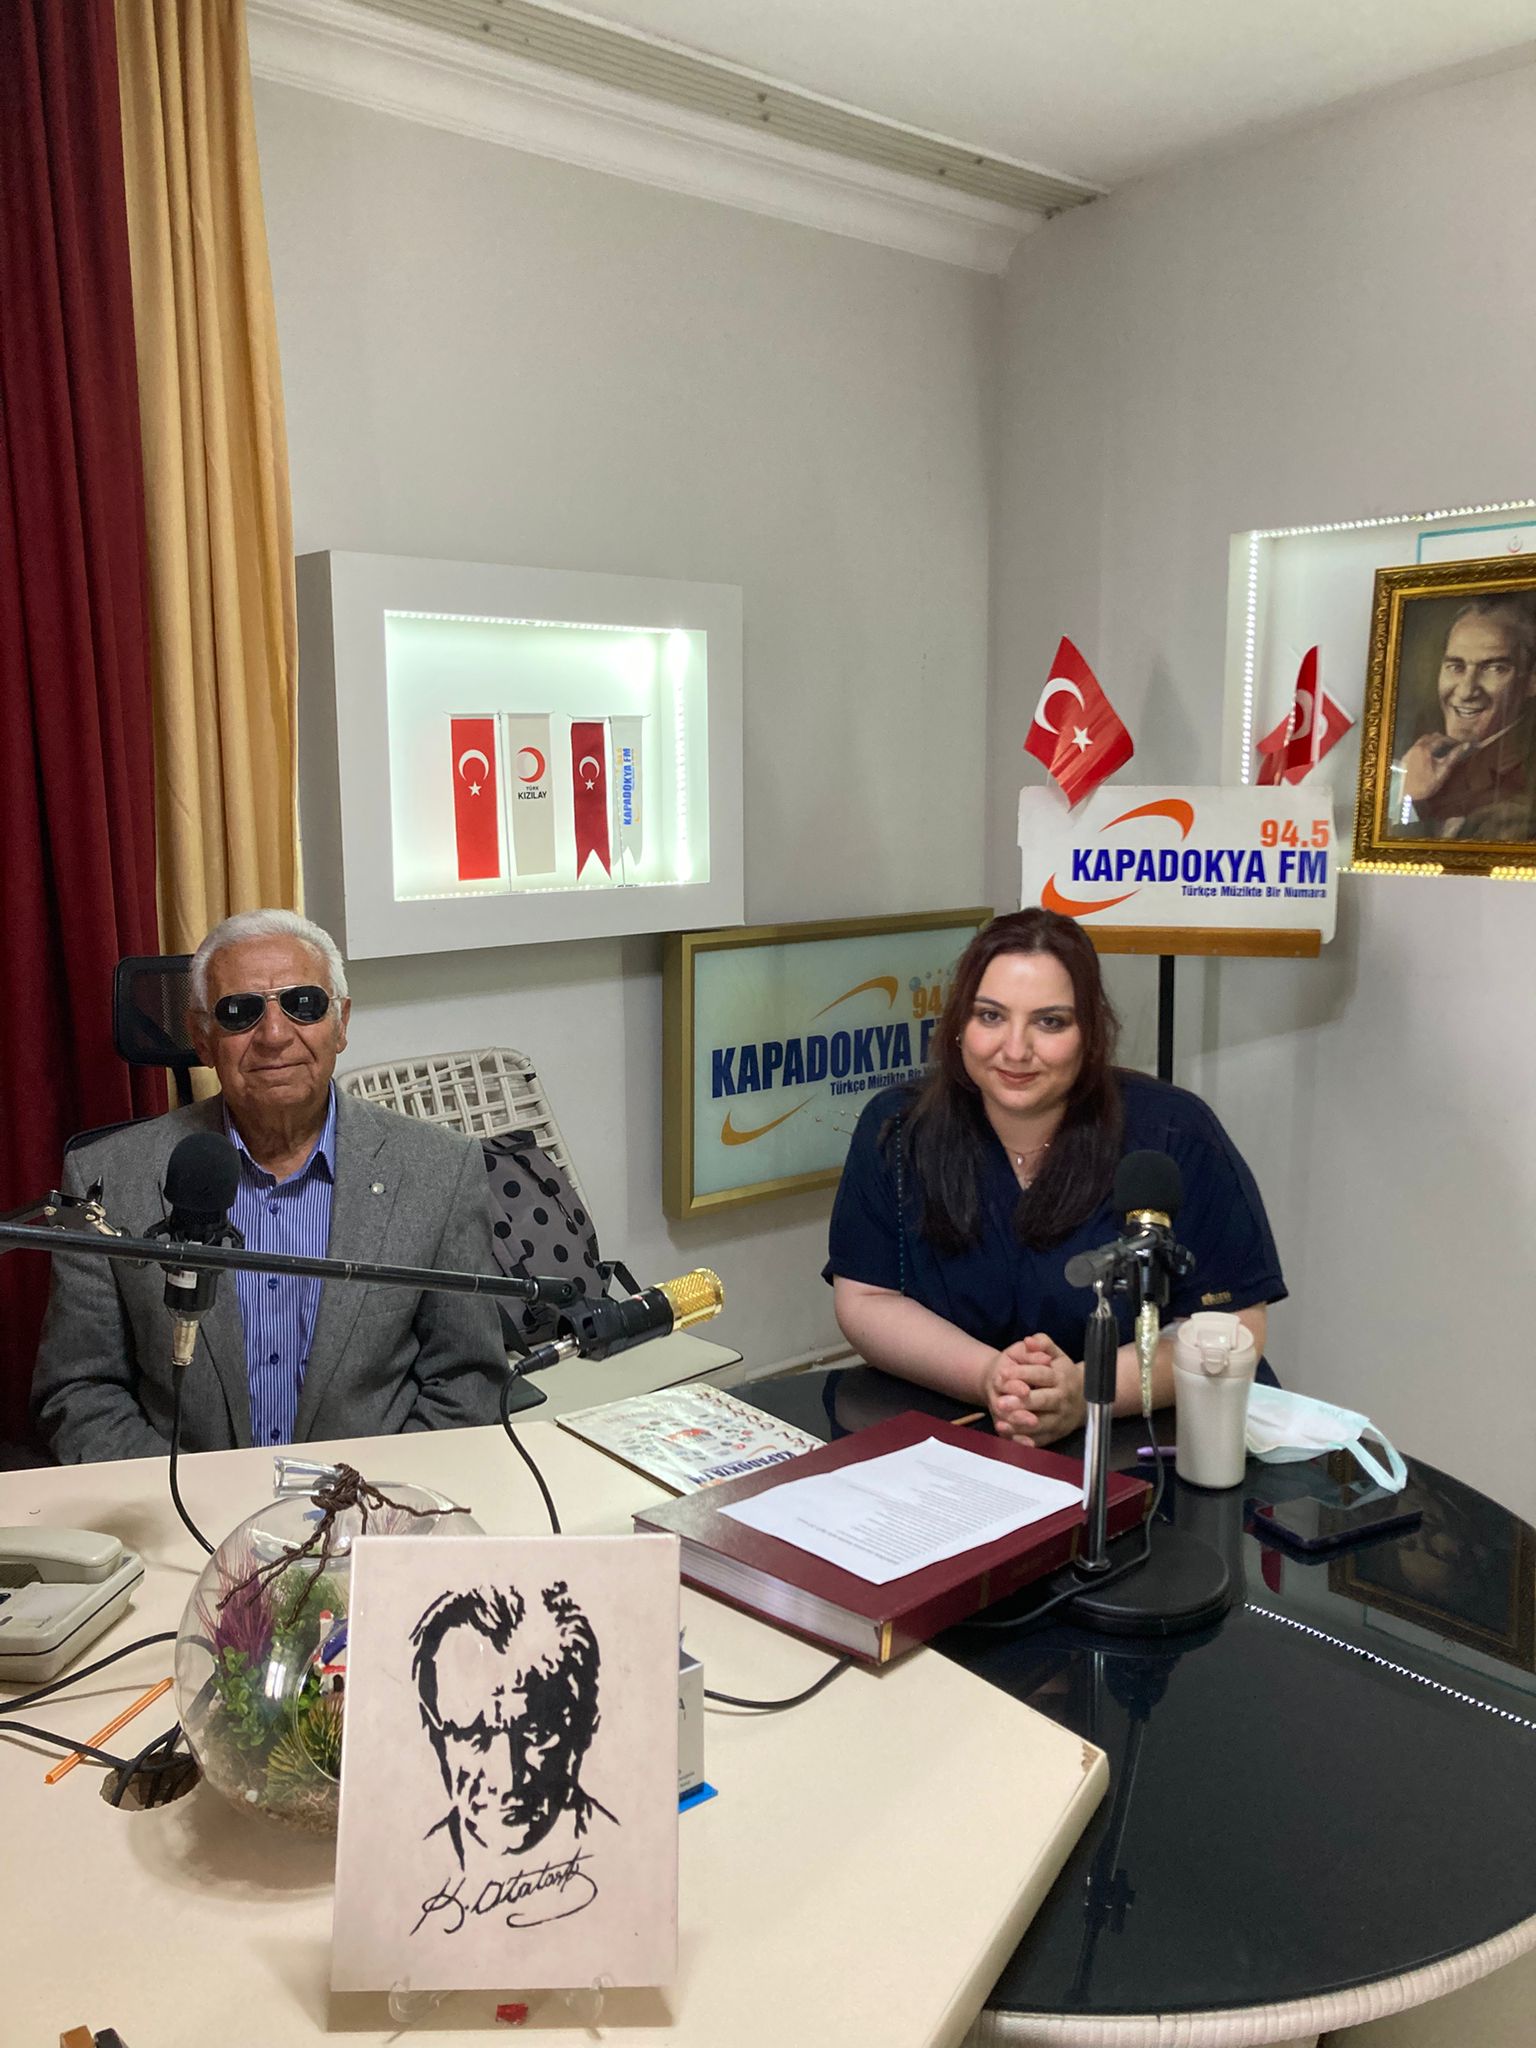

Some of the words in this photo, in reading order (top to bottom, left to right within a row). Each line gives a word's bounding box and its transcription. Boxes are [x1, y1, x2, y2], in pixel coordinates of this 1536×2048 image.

[517, 791, 547, 800] KIZILAY
[623, 765, 632, 825] KAPADOKYA
[1260, 819, 1329, 848] 94.5
[1072, 848, 1266, 883] KAPADOKYA
[1278, 850, 1328, 884] FM
[1181, 885, 1217, 897] Türkçe
[1220, 886, 1262, 897] Müzikte
[1265, 886, 1280, 897] Bir
[1284, 887, 1327, 898] Numara
[712, 1022, 912, 1098] KAPADOKYA
[830, 1077, 866, 1096] Türkçe
[868, 1071, 906, 1089] Müzikte
